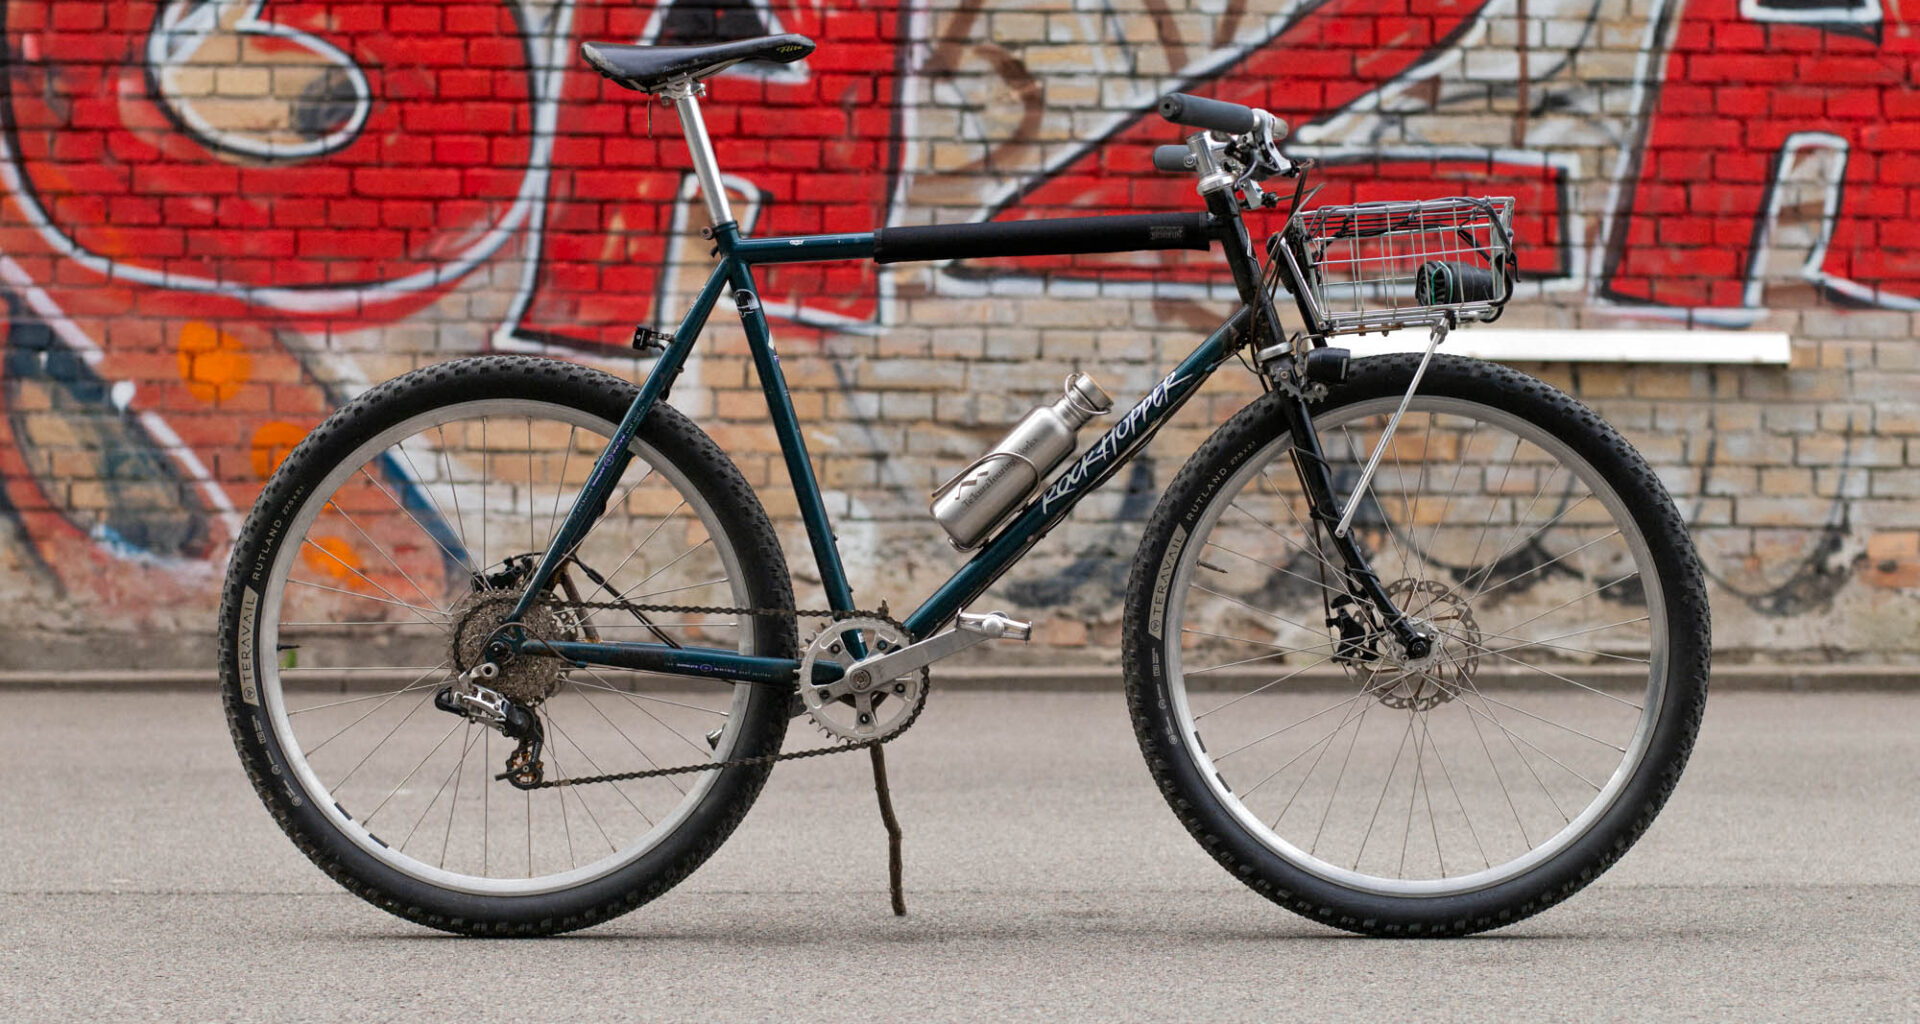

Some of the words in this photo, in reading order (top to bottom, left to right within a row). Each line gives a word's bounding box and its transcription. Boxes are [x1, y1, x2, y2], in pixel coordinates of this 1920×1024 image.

[1042, 371, 1193, 514] ROCKHOPPER
[241, 597, 256, 683] TERAVAIL
[252, 519, 282, 581] RUTLAND
[1153, 535, 1185, 616] TERAVAIL
[1186, 467, 1228, 521] RUTLAND
